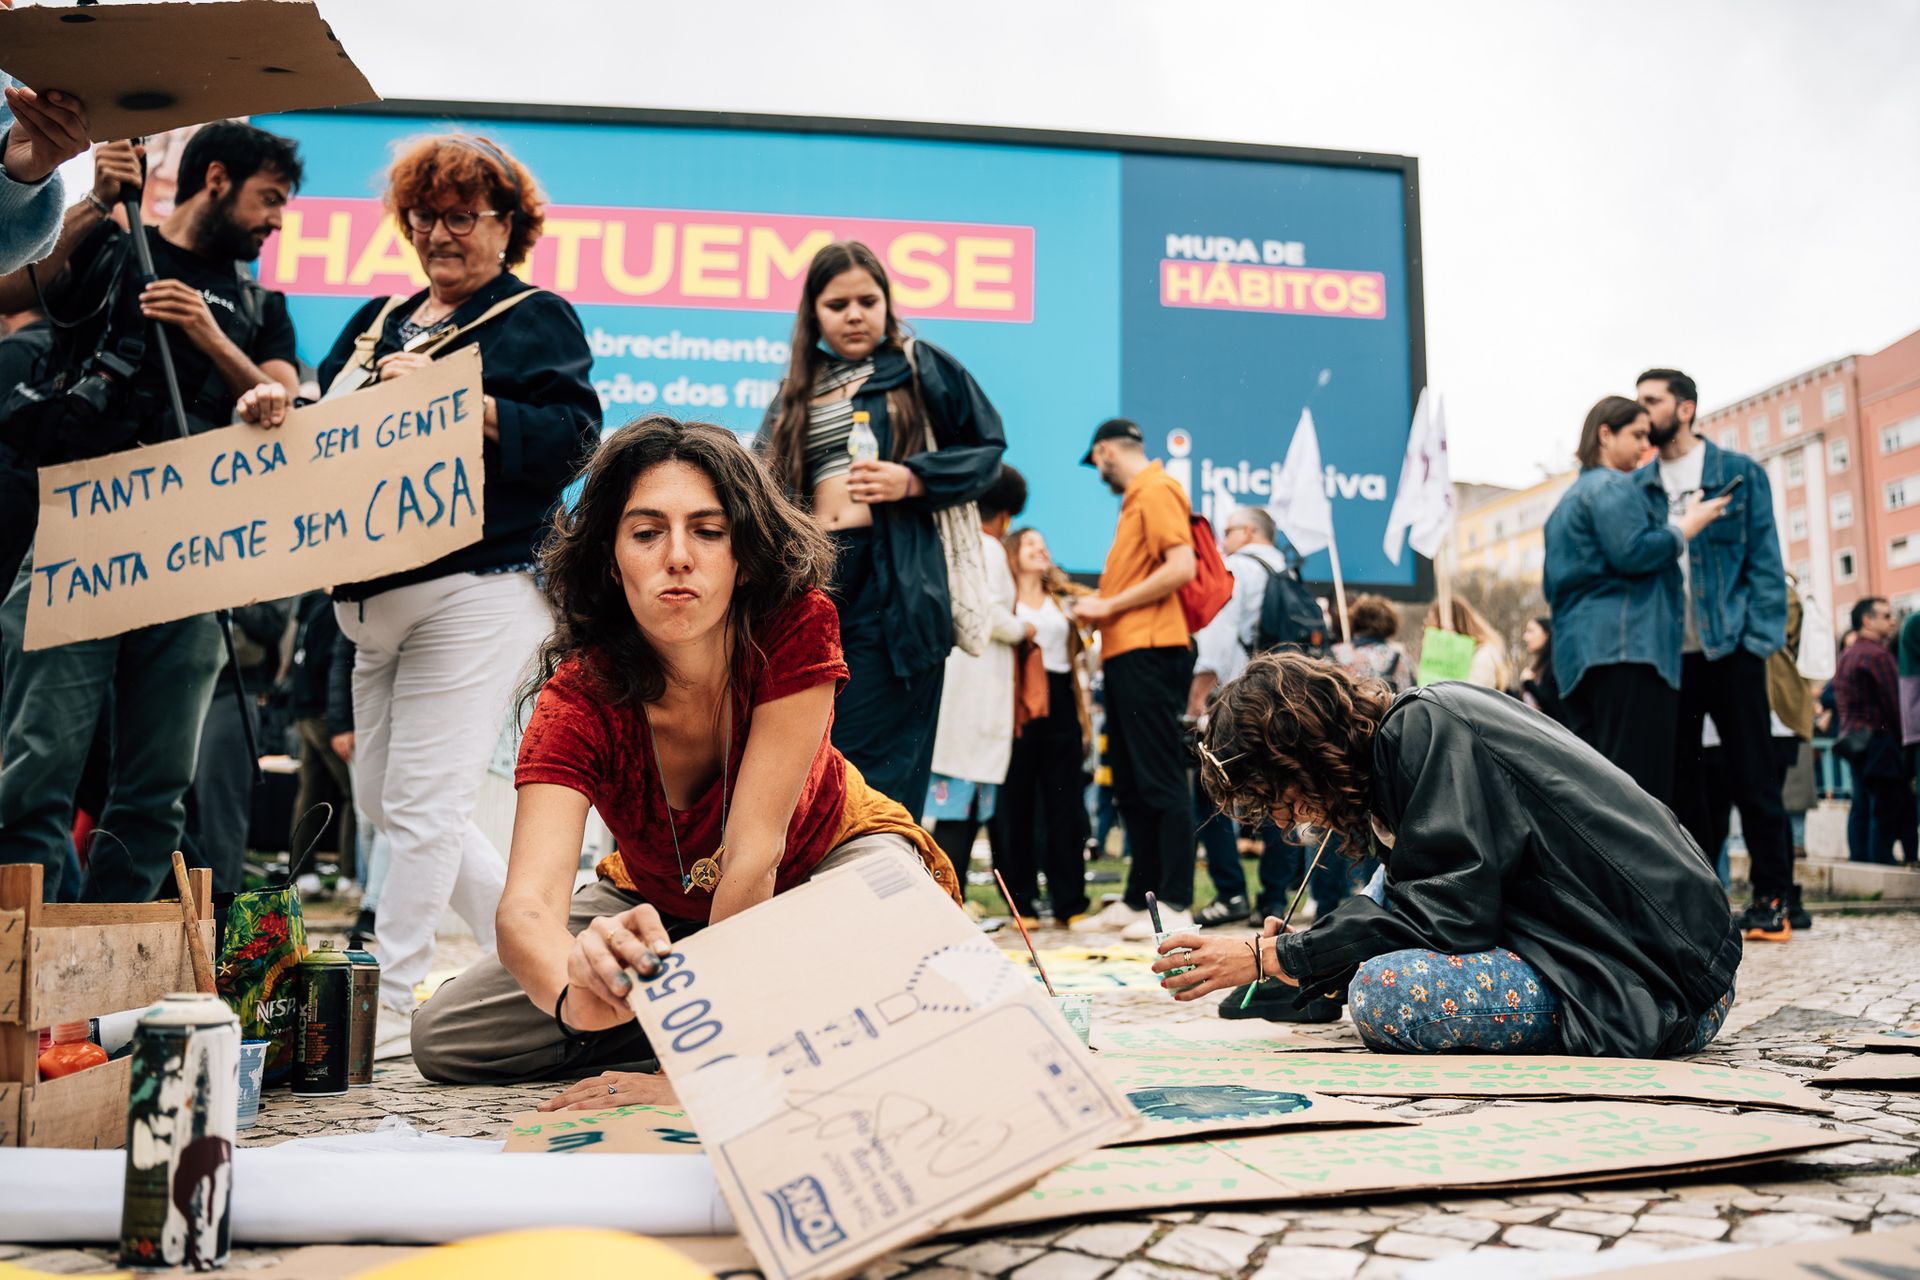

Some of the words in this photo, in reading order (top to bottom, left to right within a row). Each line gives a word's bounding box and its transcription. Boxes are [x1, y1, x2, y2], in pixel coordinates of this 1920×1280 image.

[275, 209, 1016, 310] HATUEMSE
[1165, 234, 1259, 263] MUDA
[1263, 240, 1305, 266] DE
[1166, 261, 1382, 314] HÁBITOS
[589, 327, 790, 364] brecimento
[663, 375, 728, 408] dos
[53, 464, 183, 519] TANTA
[210, 441, 288, 487] CASA
[309, 423, 360, 462] SEM
[375, 387, 470, 449] GENTE
[1201, 457, 1387, 501] iniciiva
[35, 550, 149, 607] TANTA
[166, 519, 267, 573] GENTE
[290, 509, 348, 553] SEM
[364, 456, 477, 542] CASA
[254, 997, 297, 1024] NESP
[297, 1003, 308, 1063] BLACK
[781, 1175, 845, 1253] TORK
